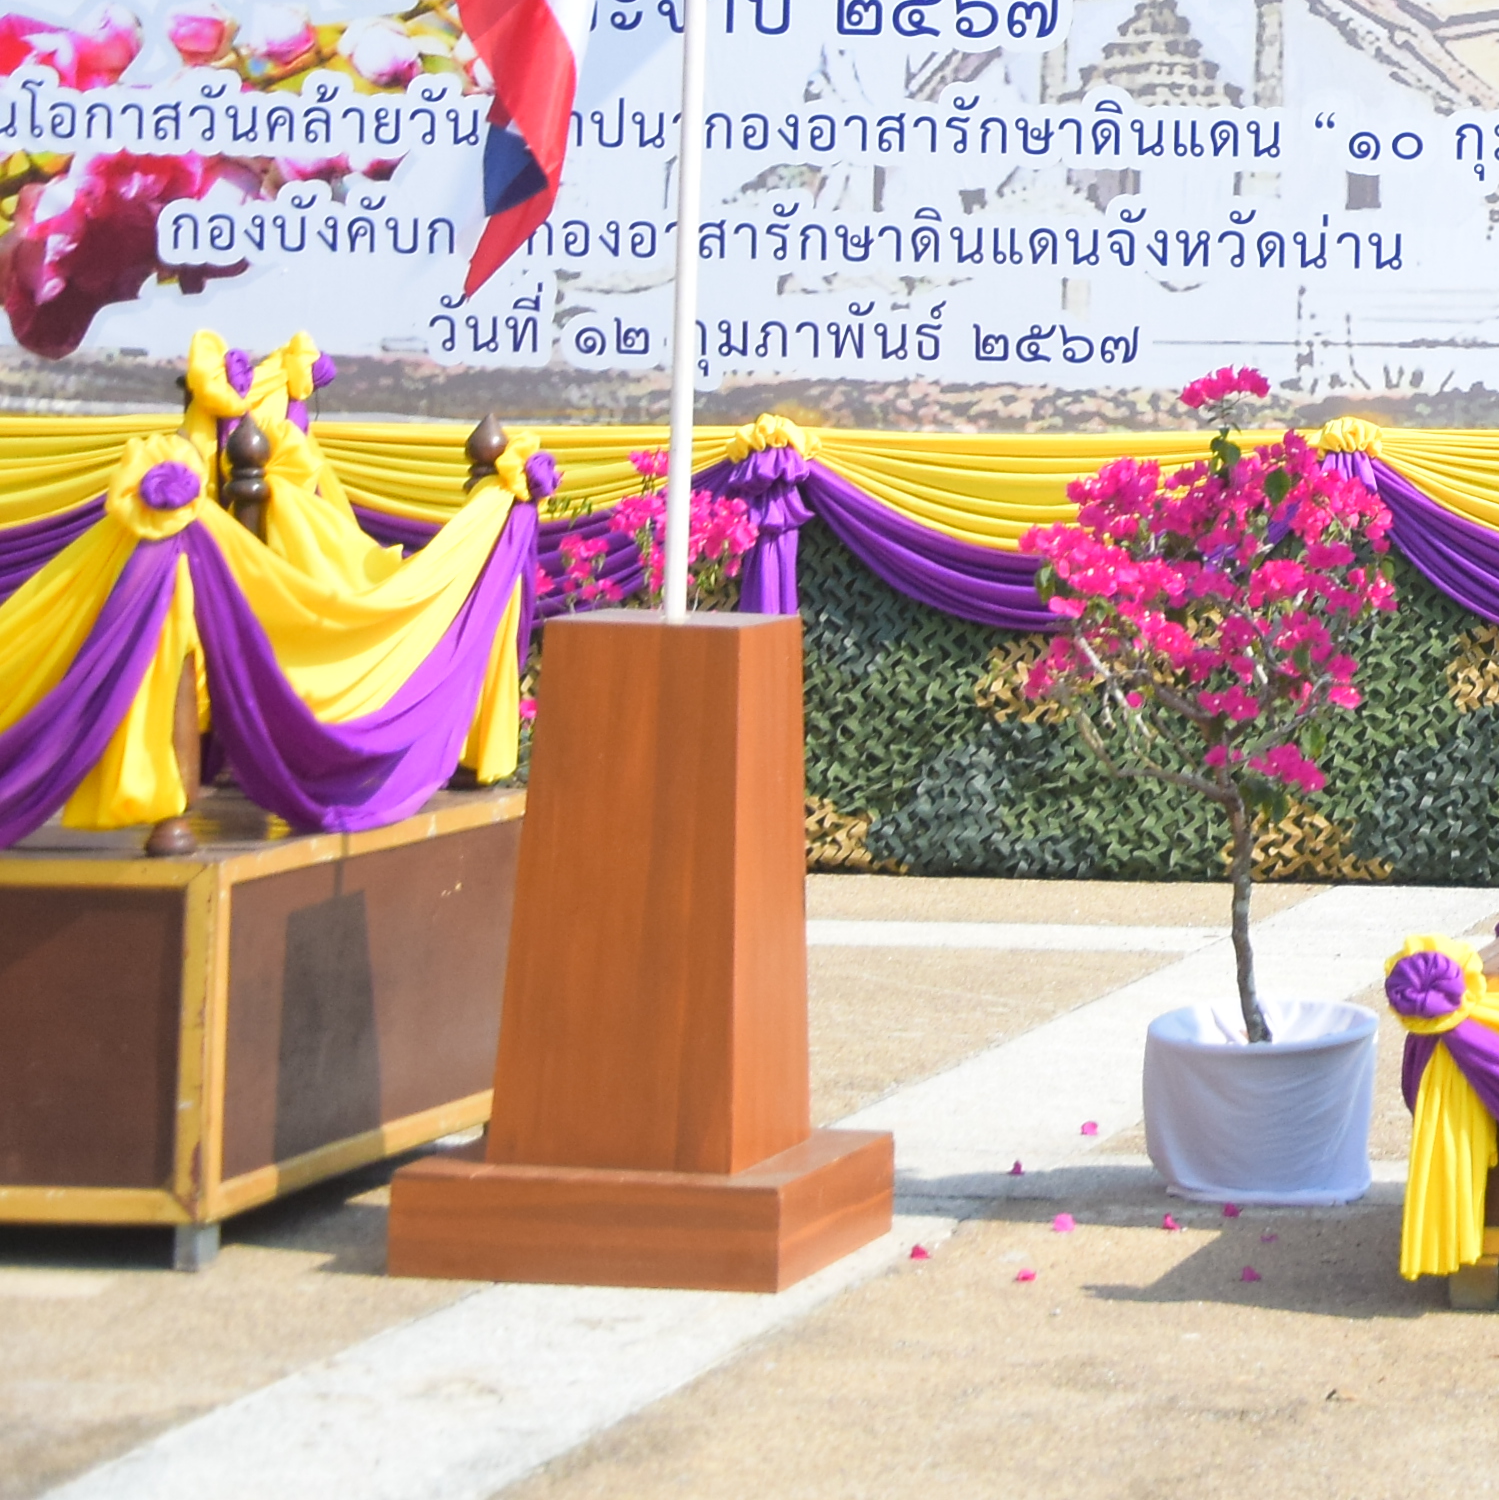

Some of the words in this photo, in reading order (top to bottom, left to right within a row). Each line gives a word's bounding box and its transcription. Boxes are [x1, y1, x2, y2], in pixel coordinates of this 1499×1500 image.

[428, 281, 544, 353] วันที่
[574, 316, 650, 356] ๑๒
[973, 322, 1140, 365] ๒๕๖๗
